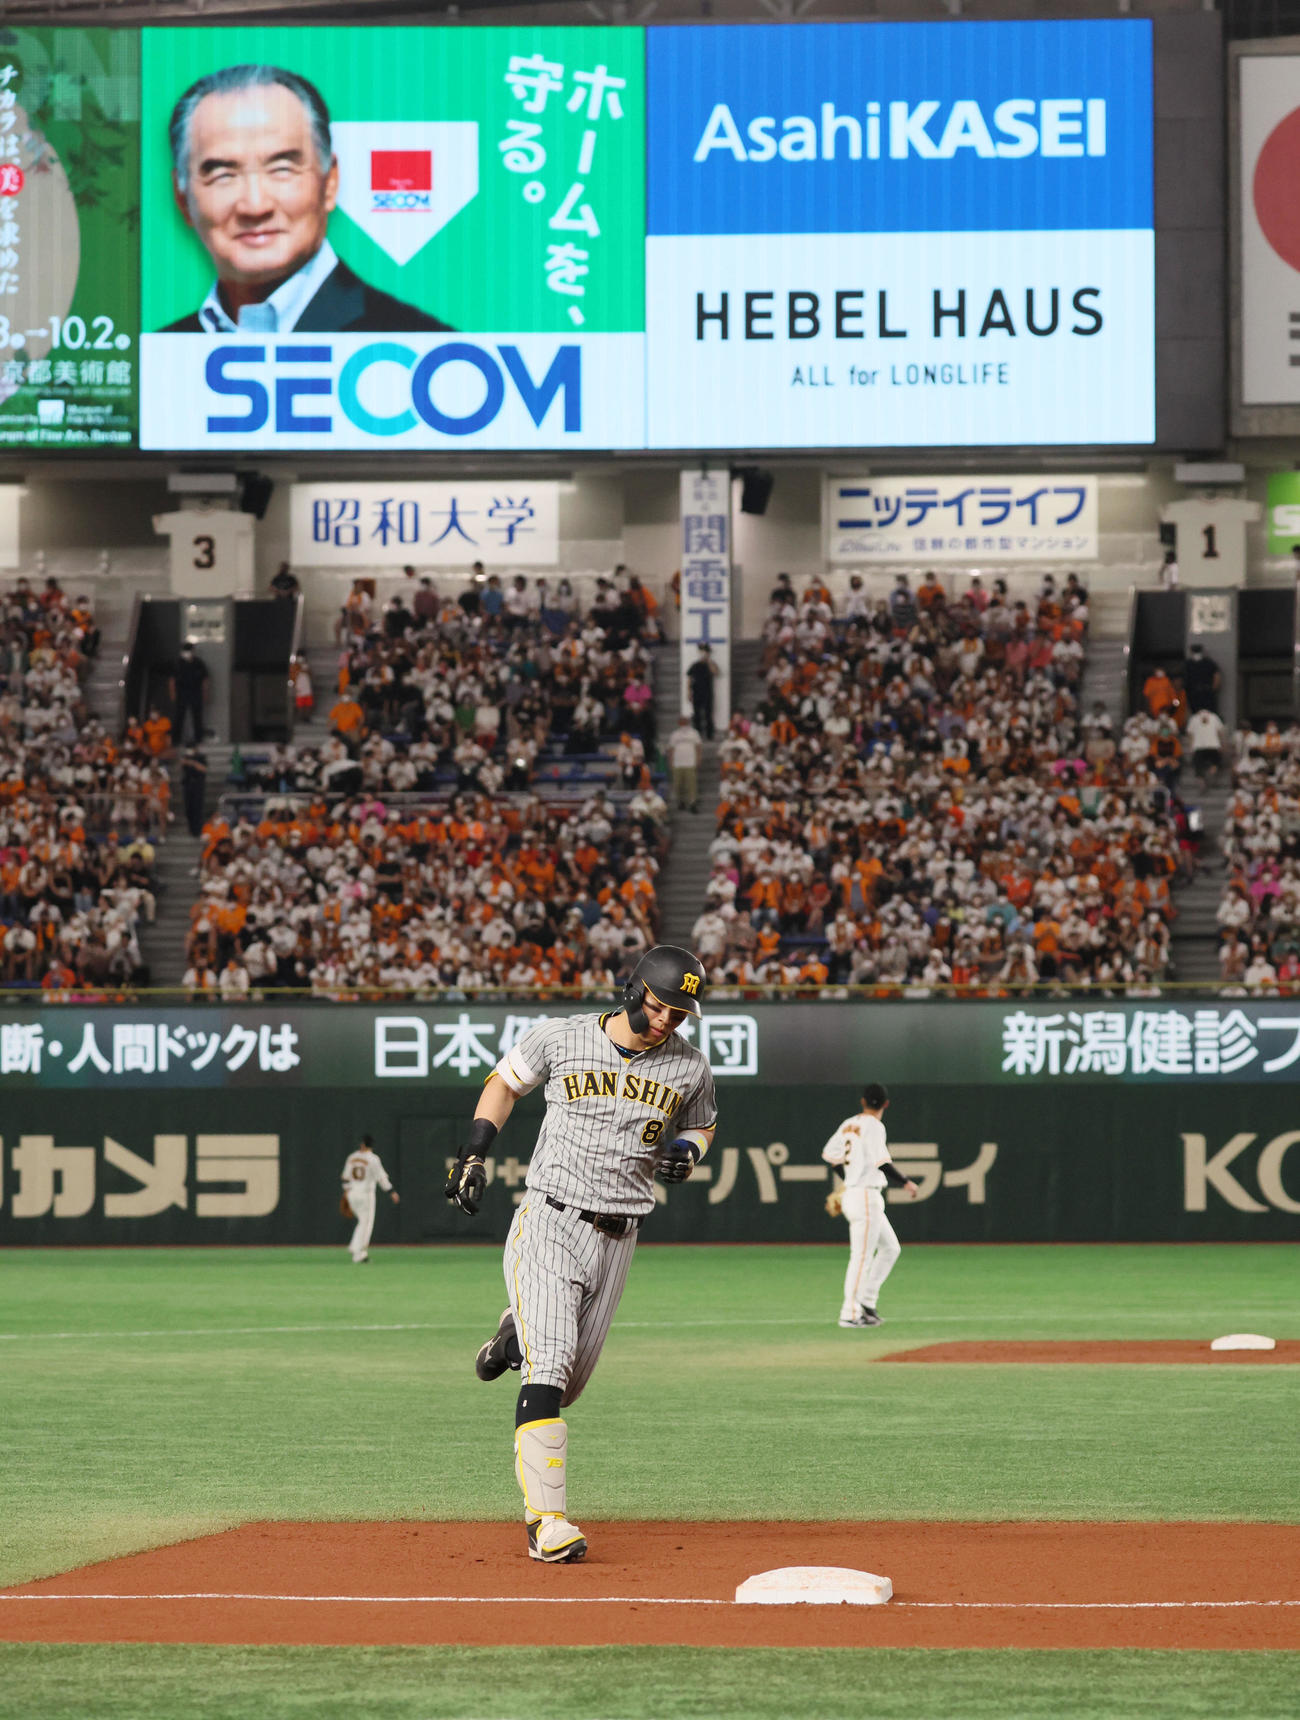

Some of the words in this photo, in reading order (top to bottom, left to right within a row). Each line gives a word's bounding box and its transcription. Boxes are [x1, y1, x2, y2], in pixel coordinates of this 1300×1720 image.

[499, 54, 564, 204] 守る。
[544, 64, 627, 326] ホームを、
[696, 289, 908, 341] HEBEL
[933, 287, 1105, 338] HAUS
[205, 342, 582, 437] SECOM
[791, 365, 835, 387] ALL
[849, 364, 878, 386] for
[890, 361, 1011, 386] LONGLIFE
[312, 496, 537, 547] 昭和大学
[838, 486, 1087, 528] ニッテイライフ
[193, 535, 215, 569] 3
[1203, 524, 1219, 558] 1
[641, 1119, 665, 1145] 8
[0, 1134, 280, 1218] カメラ
